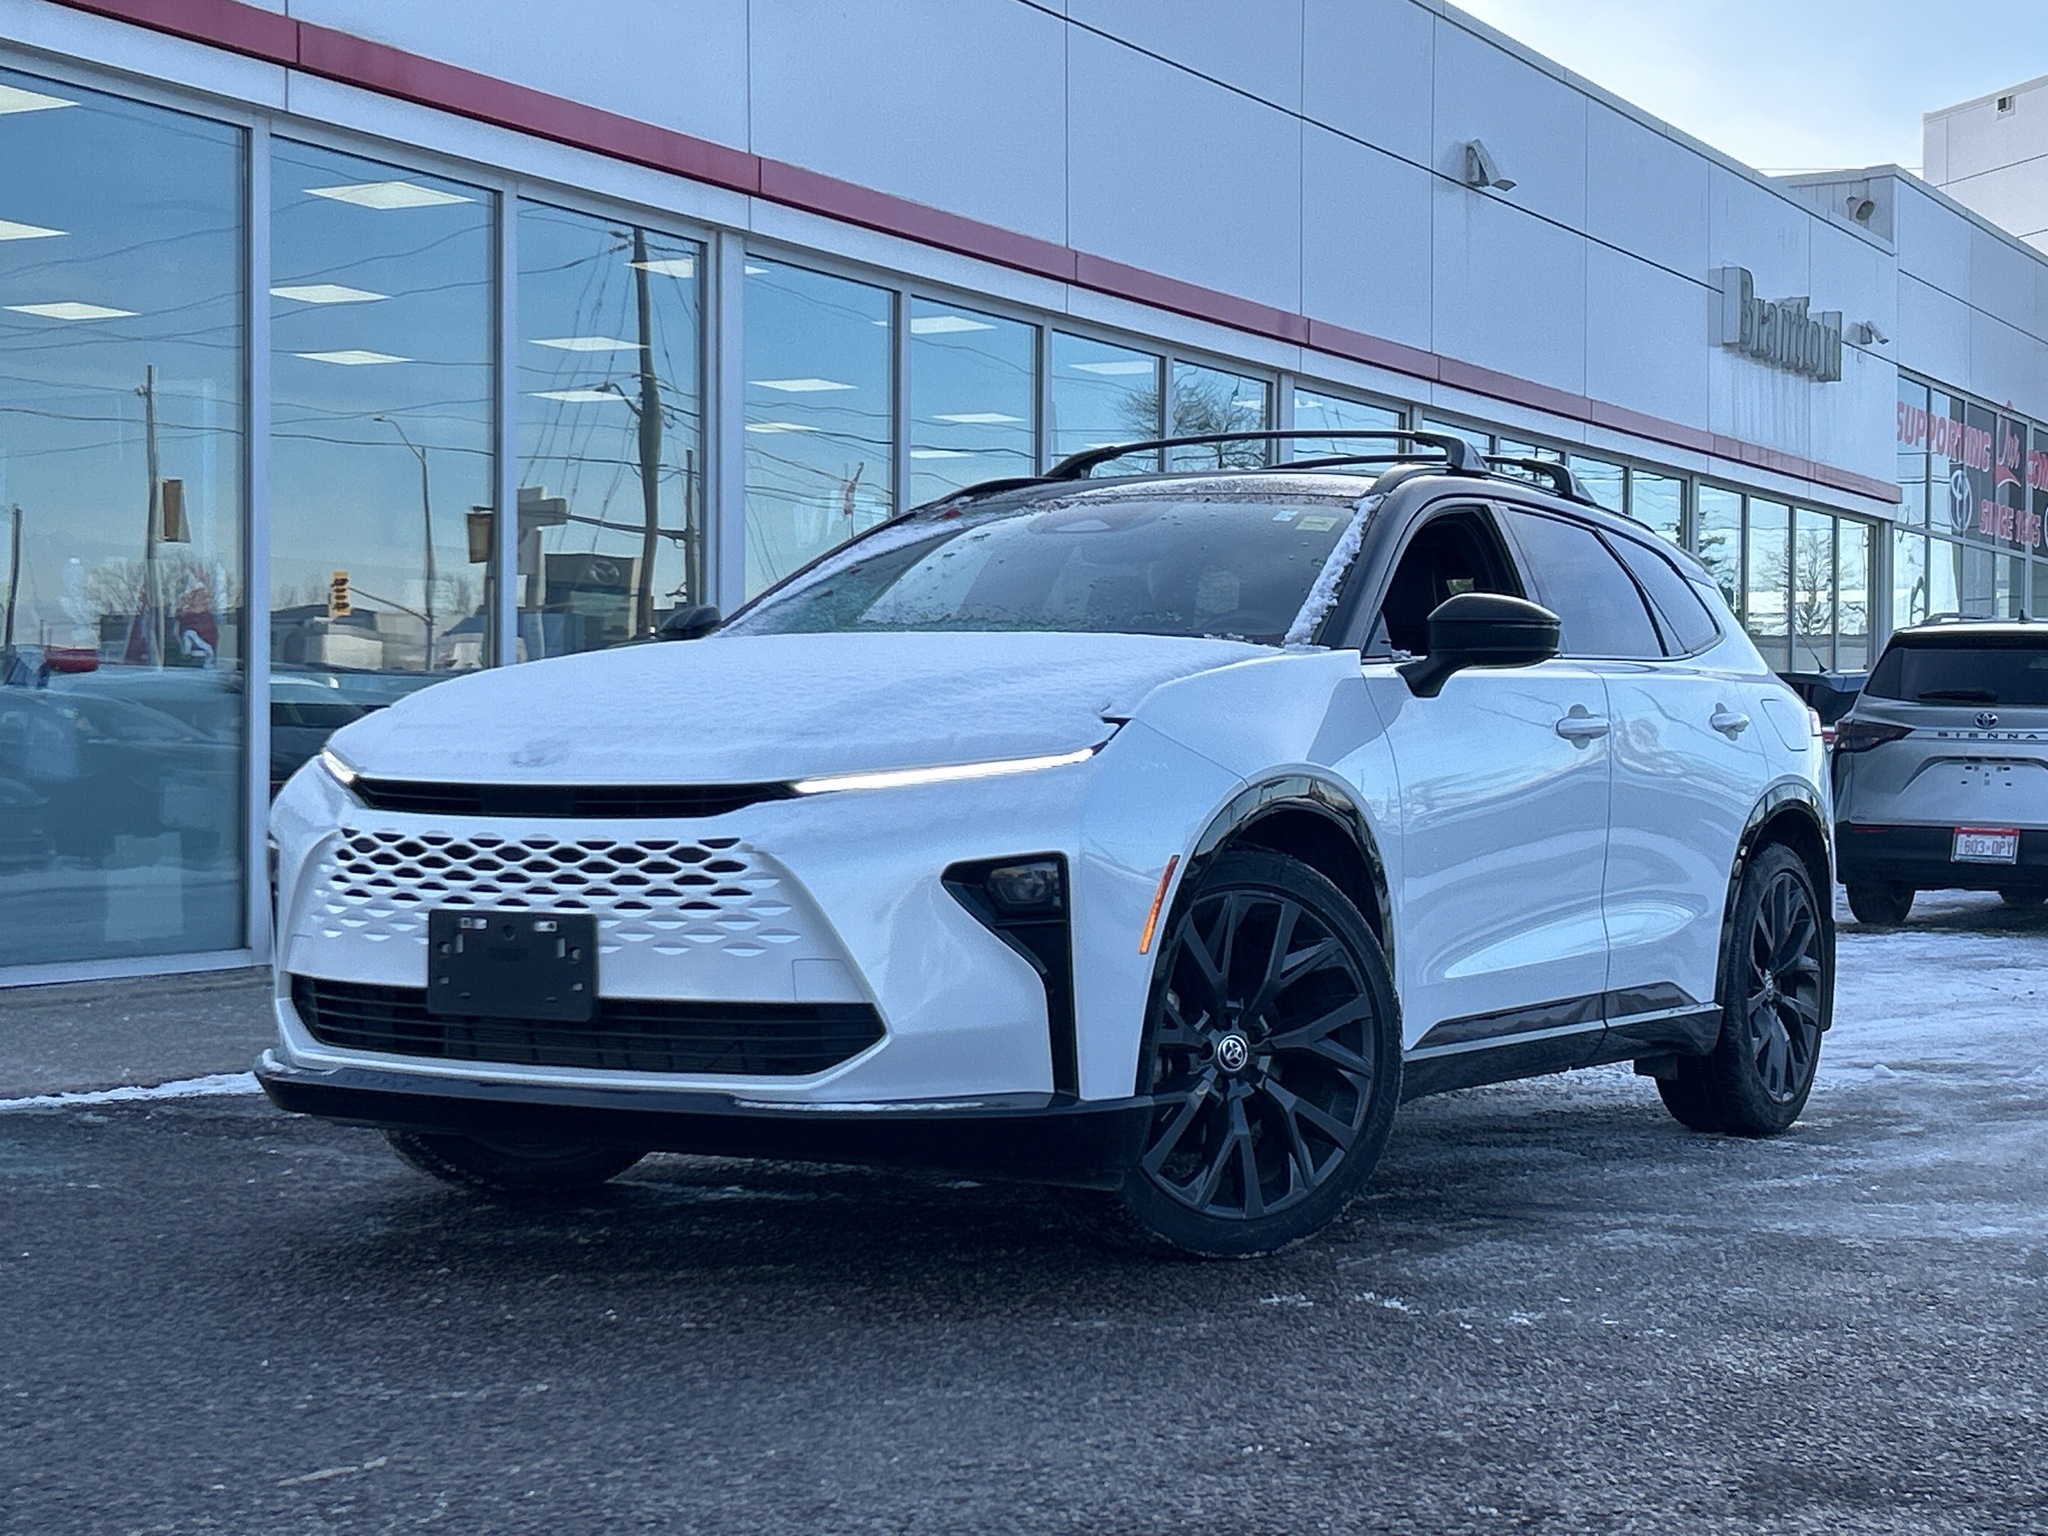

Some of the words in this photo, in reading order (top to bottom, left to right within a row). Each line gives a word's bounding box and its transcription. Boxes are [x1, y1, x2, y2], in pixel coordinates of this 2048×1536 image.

[1896, 400, 1992, 473] SUPPORTING
[1979, 499, 2014, 541] SINCE
[1937, 731, 2038, 740] SIENNA
